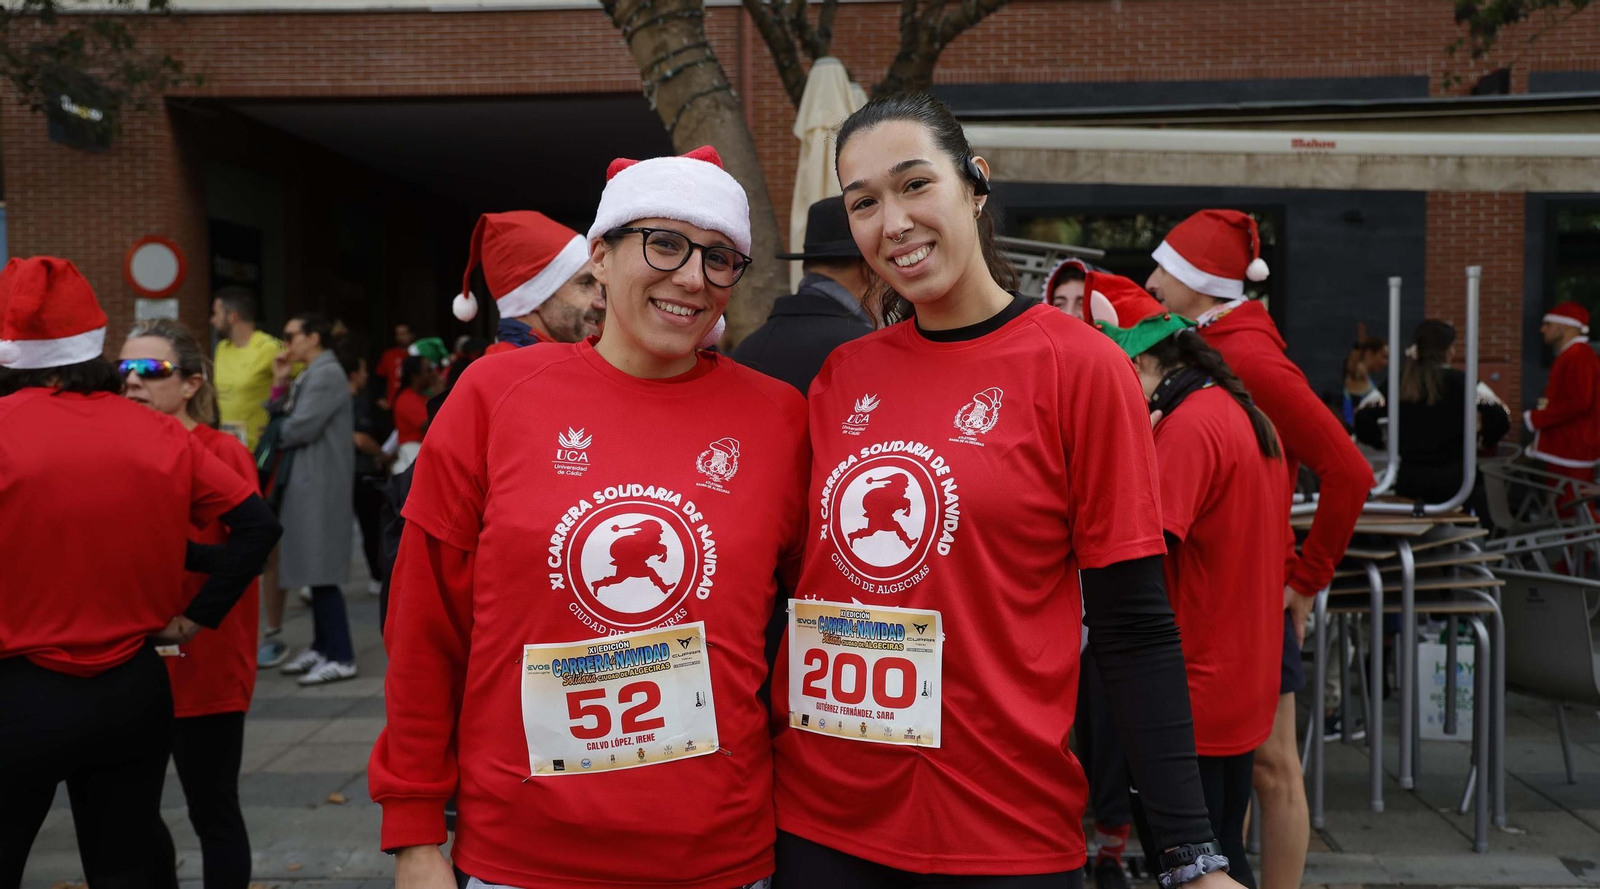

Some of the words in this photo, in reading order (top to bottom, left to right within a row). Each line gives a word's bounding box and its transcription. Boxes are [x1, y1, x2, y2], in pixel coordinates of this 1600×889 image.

[847, 414, 870, 424] UCA
[556, 449, 588, 463] UCA
[860, 440, 935, 461] SOLIDARIA
[930, 456, 951, 477] DE
[593, 484, 682, 507] SOLIDARIA
[820, 454, 858, 520] CARRERA
[682, 501, 704, 524] DE
[937, 477, 961, 557] NAVIDAD
[547, 499, 593, 569] CARRERA
[820, 524, 828, 541] XI
[696, 523, 718, 601] NAVIDAD
[549, 573, 565, 591] XI
[831, 553, 862, 586] CIUDAD
[862, 581, 875, 593] DE
[876, 564, 930, 595] ALGECIRAS
[568, 602, 607, 635] CIUDAD
[846, 610, 870, 620] EDICIÓN
[818, 615, 854, 638] CARRERA
[856, 619, 905, 642] NAVIDAD
[588, 646, 597, 654] XI
[598, 640, 630, 653] EDICIÓN
[672, 650, 701, 659] CUPRA
[865, 640, 905, 651] ALGECIRAS
[552, 653, 613, 678] CARRERA
[614, 642, 670, 670] NAVIDAD
[597, 672, 620, 682] CIUDAD
[620, 670, 630, 678] DE
[630, 661, 671, 677] ALGECIRAS
[802, 648, 918, 709] 200
[566, 681, 665, 740] 52
[815, 701, 839, 714] GUTIÉRREZ
[839, 704, 875, 719] FERNÁNDEZ,
[876, 710, 895, 721] SARA
[586, 741, 609, 751] CALVO
[610, 736, 634, 749] LÓPEZ,
[635, 733, 656, 745] IRENE
